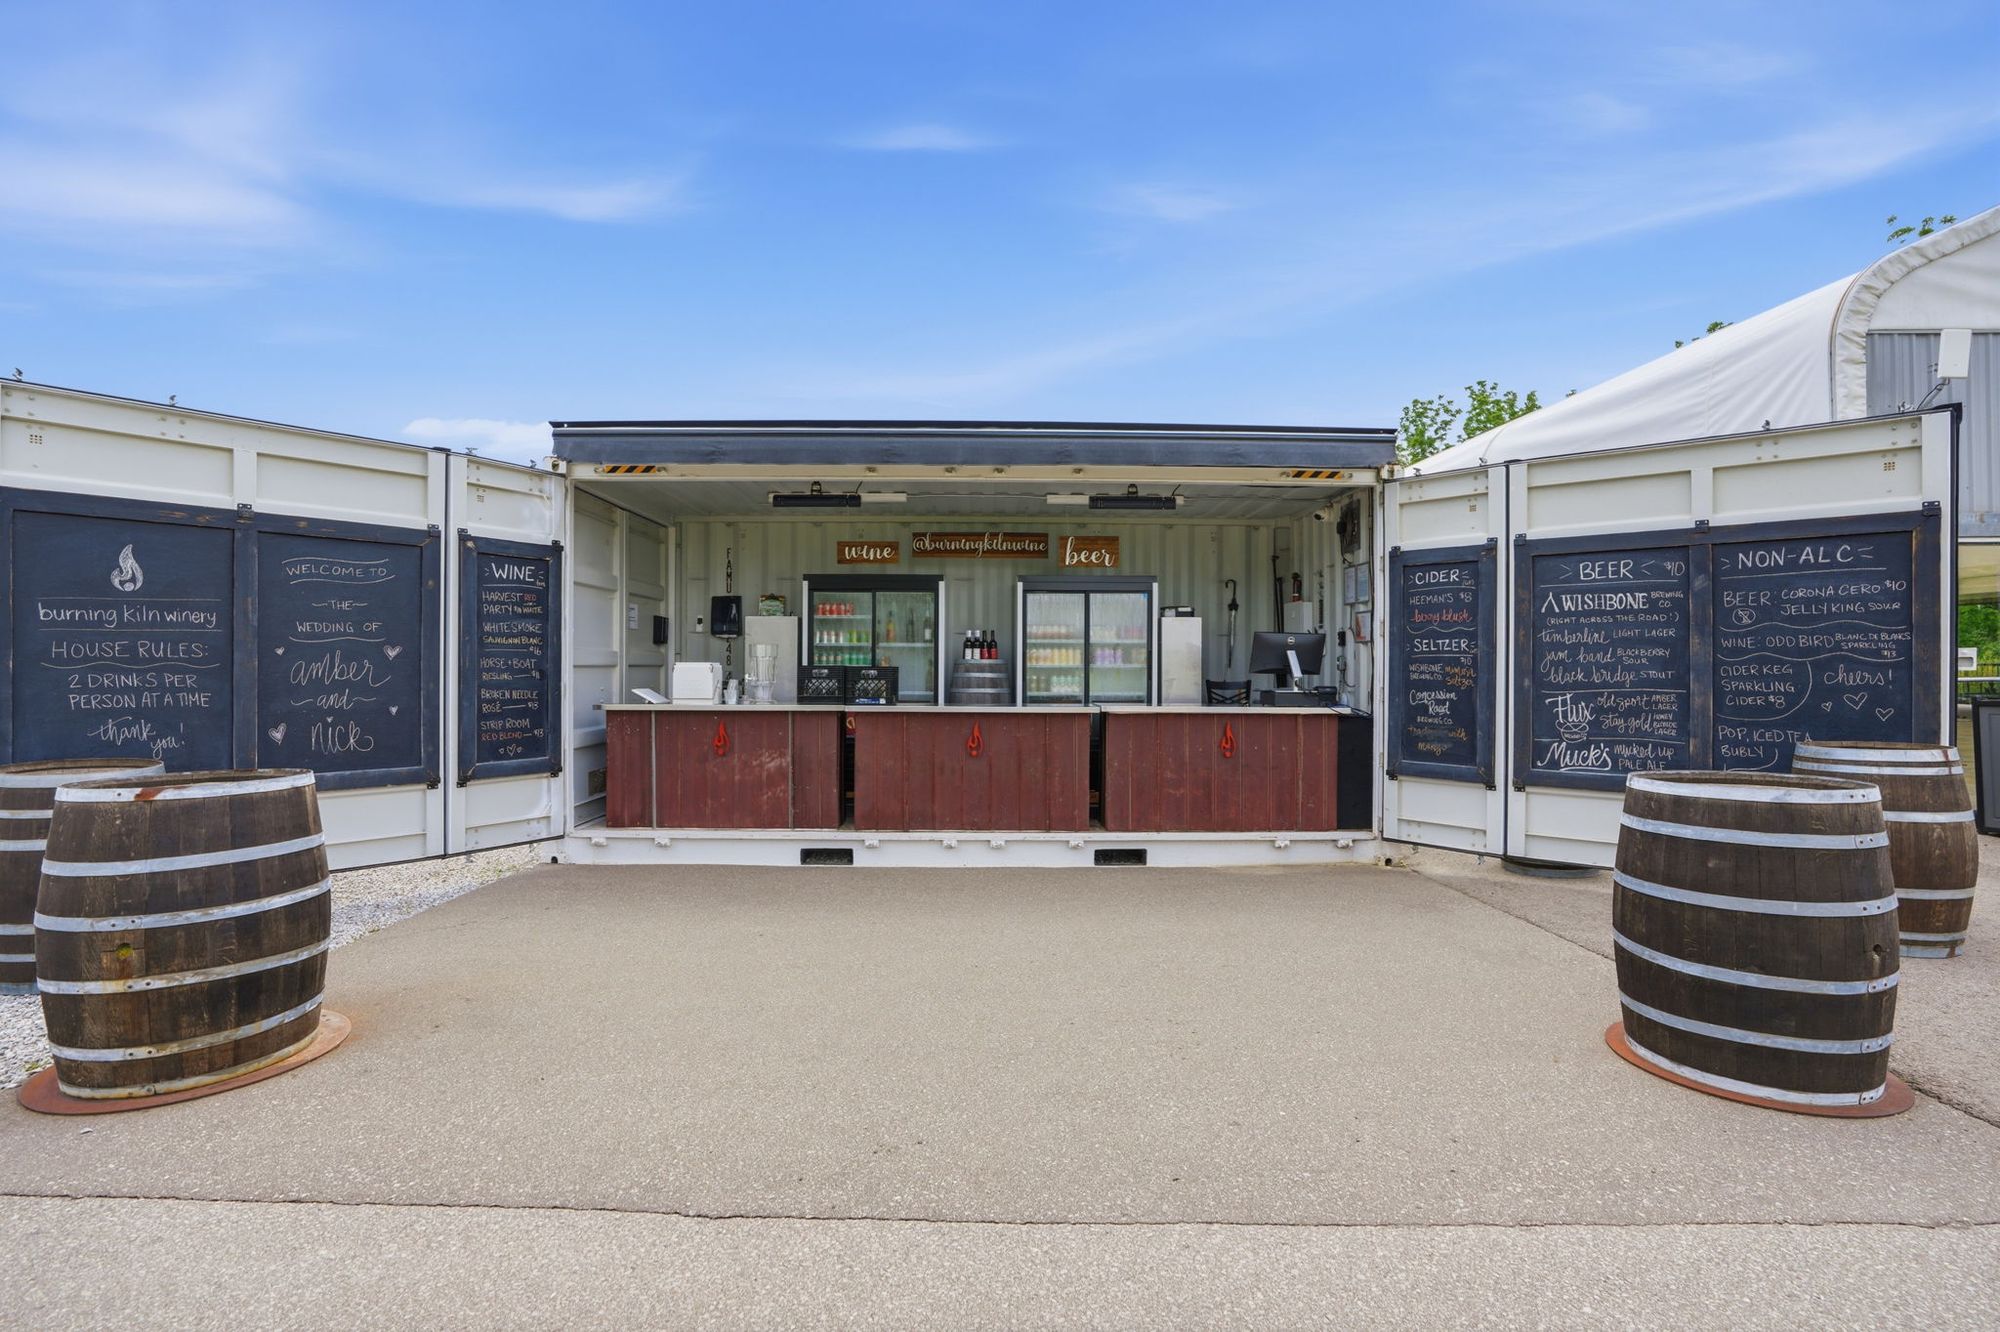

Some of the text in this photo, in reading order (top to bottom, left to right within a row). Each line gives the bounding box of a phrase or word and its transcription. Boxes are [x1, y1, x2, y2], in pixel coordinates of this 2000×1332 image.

[844, 544, 895, 560] wine
[913, 532, 1048, 559] @burningkilnwine
[1065, 536, 1114, 566] beer
[1739, 544, 1854, 570] NON-ALC
[286, 565, 387, 577] WELCOME TO
[492, 563, 535, 581] WINE
[1416, 569, 1459, 584] CIDER
[1580, 560, 1685, 580] BEER $10
[482, 592, 522, 601] HARVEST
[1410, 593, 1453, 605] HEEMAN'S
[1560, 591, 1683, 612] WISHBONE BREWING
[1724, 591, 1777, 607] BEER:
[1782, 586, 1834, 599] CORONA
[1839, 584, 1880, 595] CERO
[328, 600, 353, 610] THE
[483, 604, 512, 615] PARTY
[1781, 603, 1827, 615] JELLY
[1832, 602, 1865, 613] KING
[38, 602, 216, 628] burning kiln winery
[1547, 617, 1577, 625] (RIGHT
[1579, 614, 1613, 623] ACROSS
[297, 622, 383, 632] WEDDING OF
[483, 623, 510, 632] WHITE
[1537, 628, 1676, 644] timberline LIGHT LAGER
[1721, 637, 1761, 648] WINE:
[1766, 636, 1795, 647] ODD
[1799, 635, 1834, 647] BIRD
[52, 640, 208, 657] HOUSE RULES:
[1415, 639, 1470, 651] SELTZER
[1841, 641, 1896, 649] SPARKLING
[480, 657, 508, 668] HORSE
[512, 658, 536, 669] BOAT
[1540, 647, 1671, 673] jam band BLACKBERRY
[1623, 656, 1649, 664] SOUR
[291, 650, 391, 687] amber
[1543, 666, 1588, 683] black
[1592, 665, 1638, 687] bridge
[1721, 664, 1892, 688] CIDER KEG cheers!
[69, 673, 196, 688] 2 DRINKS PER
[1721, 681, 1795, 692] SPARKLING
[317, 689, 354, 709] and
[481, 688, 510, 699] BROKEN
[1726, 696, 1765, 706] CIDER
[69, 693, 211, 710] PERSON AT A TIME
[1545, 693, 1596, 723] Flux
[1597, 692, 1616, 708] old
[87, 717, 156, 745] thank
[481, 718, 530, 730] STRIP ROOM
[1628, 713, 1652, 734] gold
[151, 723, 185, 758] you!
[481, 733, 498, 741] RED
[1754, 730, 1784, 742] ICED
[1537, 742, 1612, 771] Muck's
[1721, 745, 1763, 758] BUBLY
[1619, 760, 1641, 770] PALE
